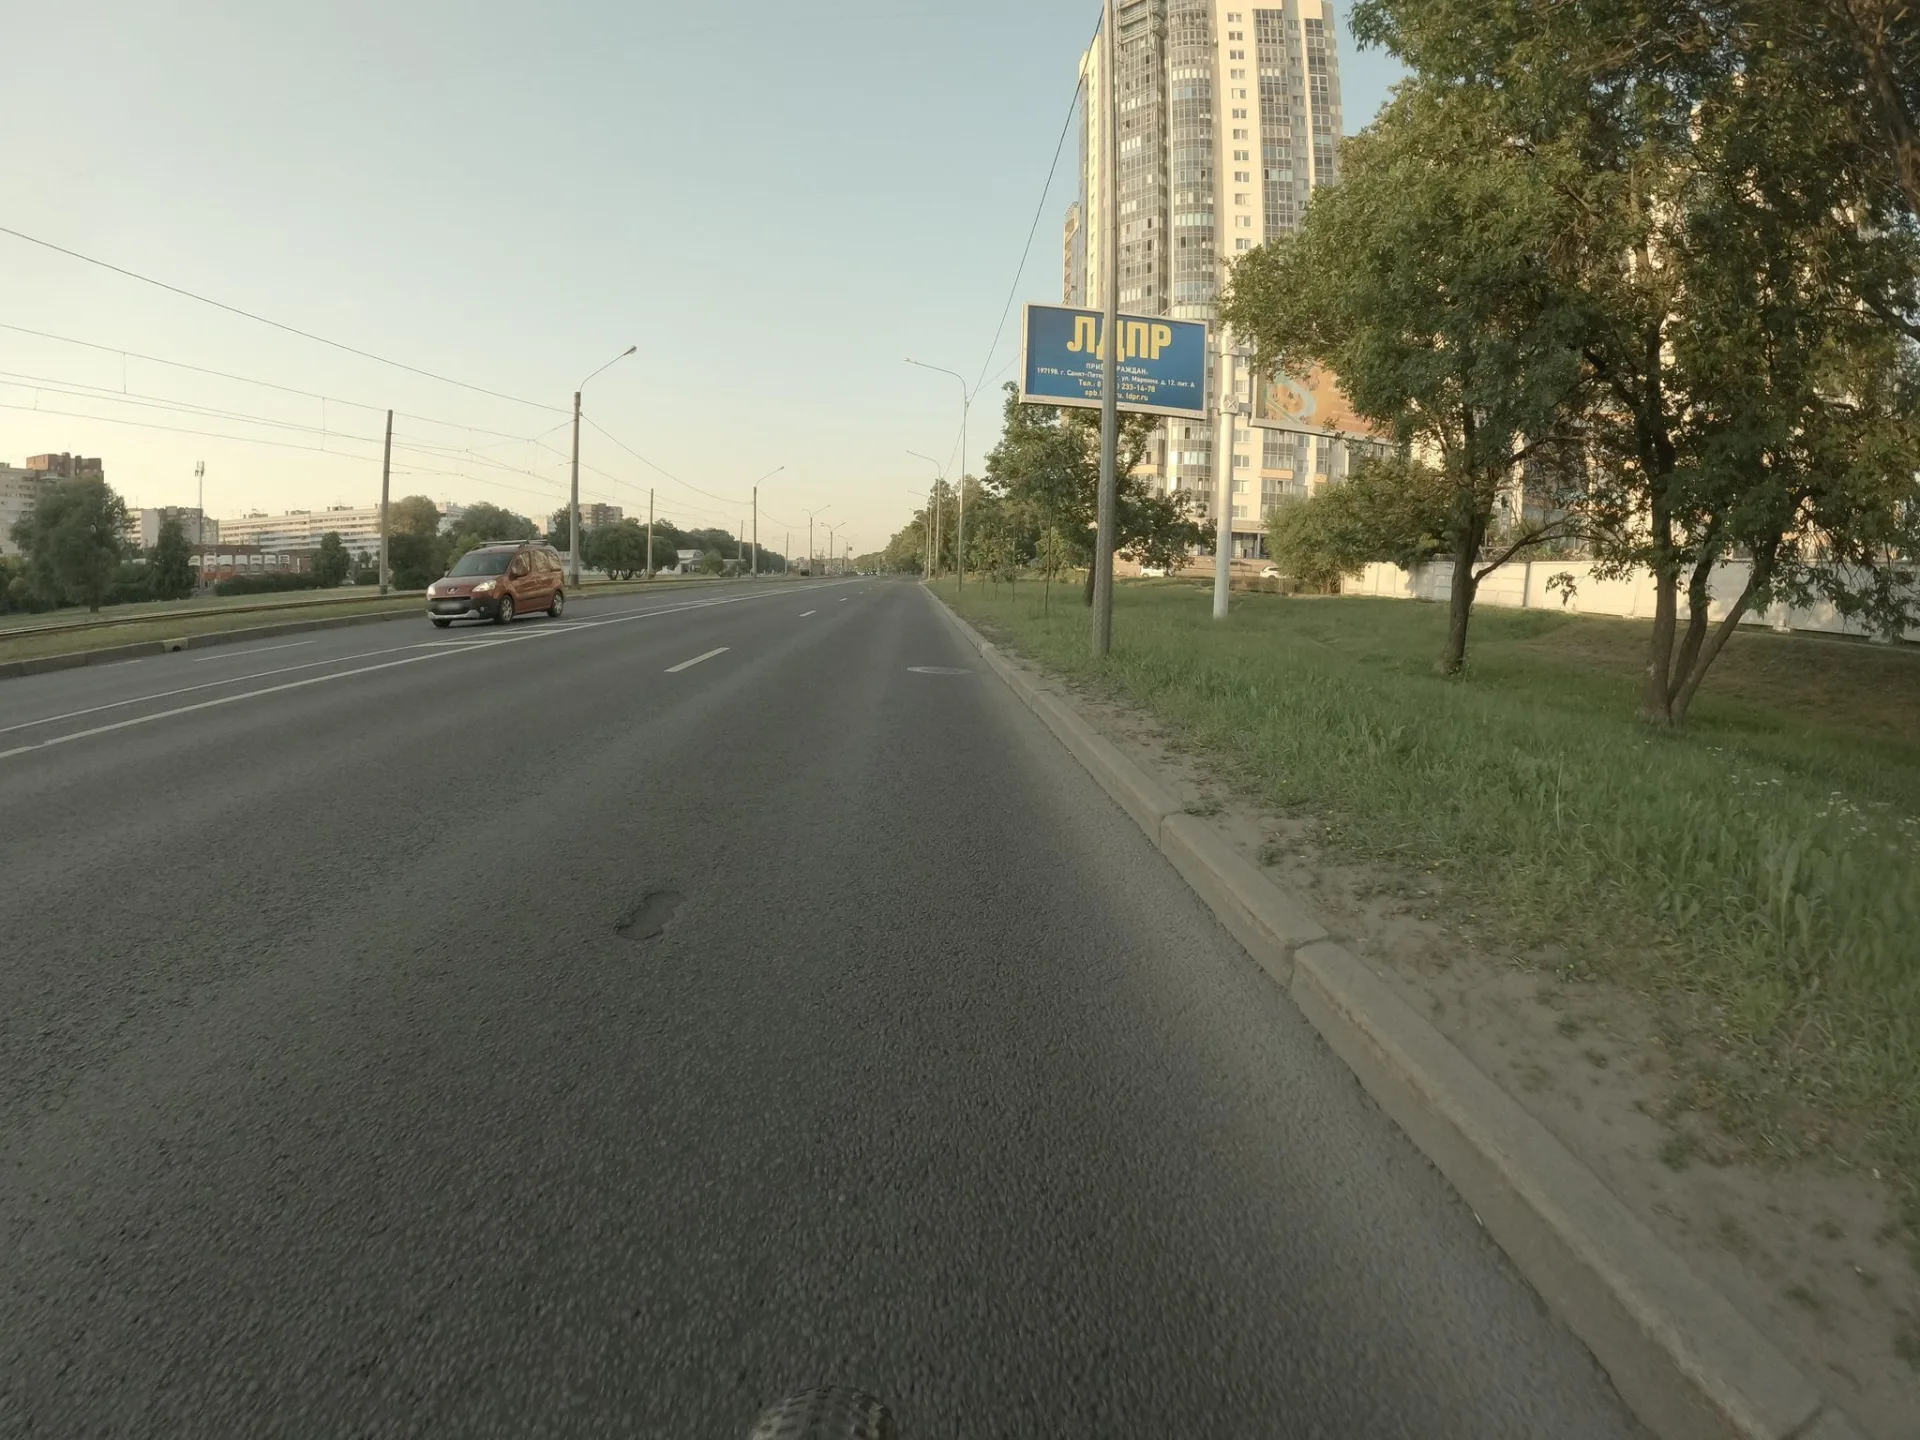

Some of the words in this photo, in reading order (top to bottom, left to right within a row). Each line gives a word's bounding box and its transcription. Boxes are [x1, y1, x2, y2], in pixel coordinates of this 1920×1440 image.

[1066, 315, 1172, 362] ЛДПР
[1116, 365, 1148, 375] РАЖДАН:
[1121, 382, 1156, 393] 233-14-78
[1125, 392, 1149, 402] ldpr.ru
